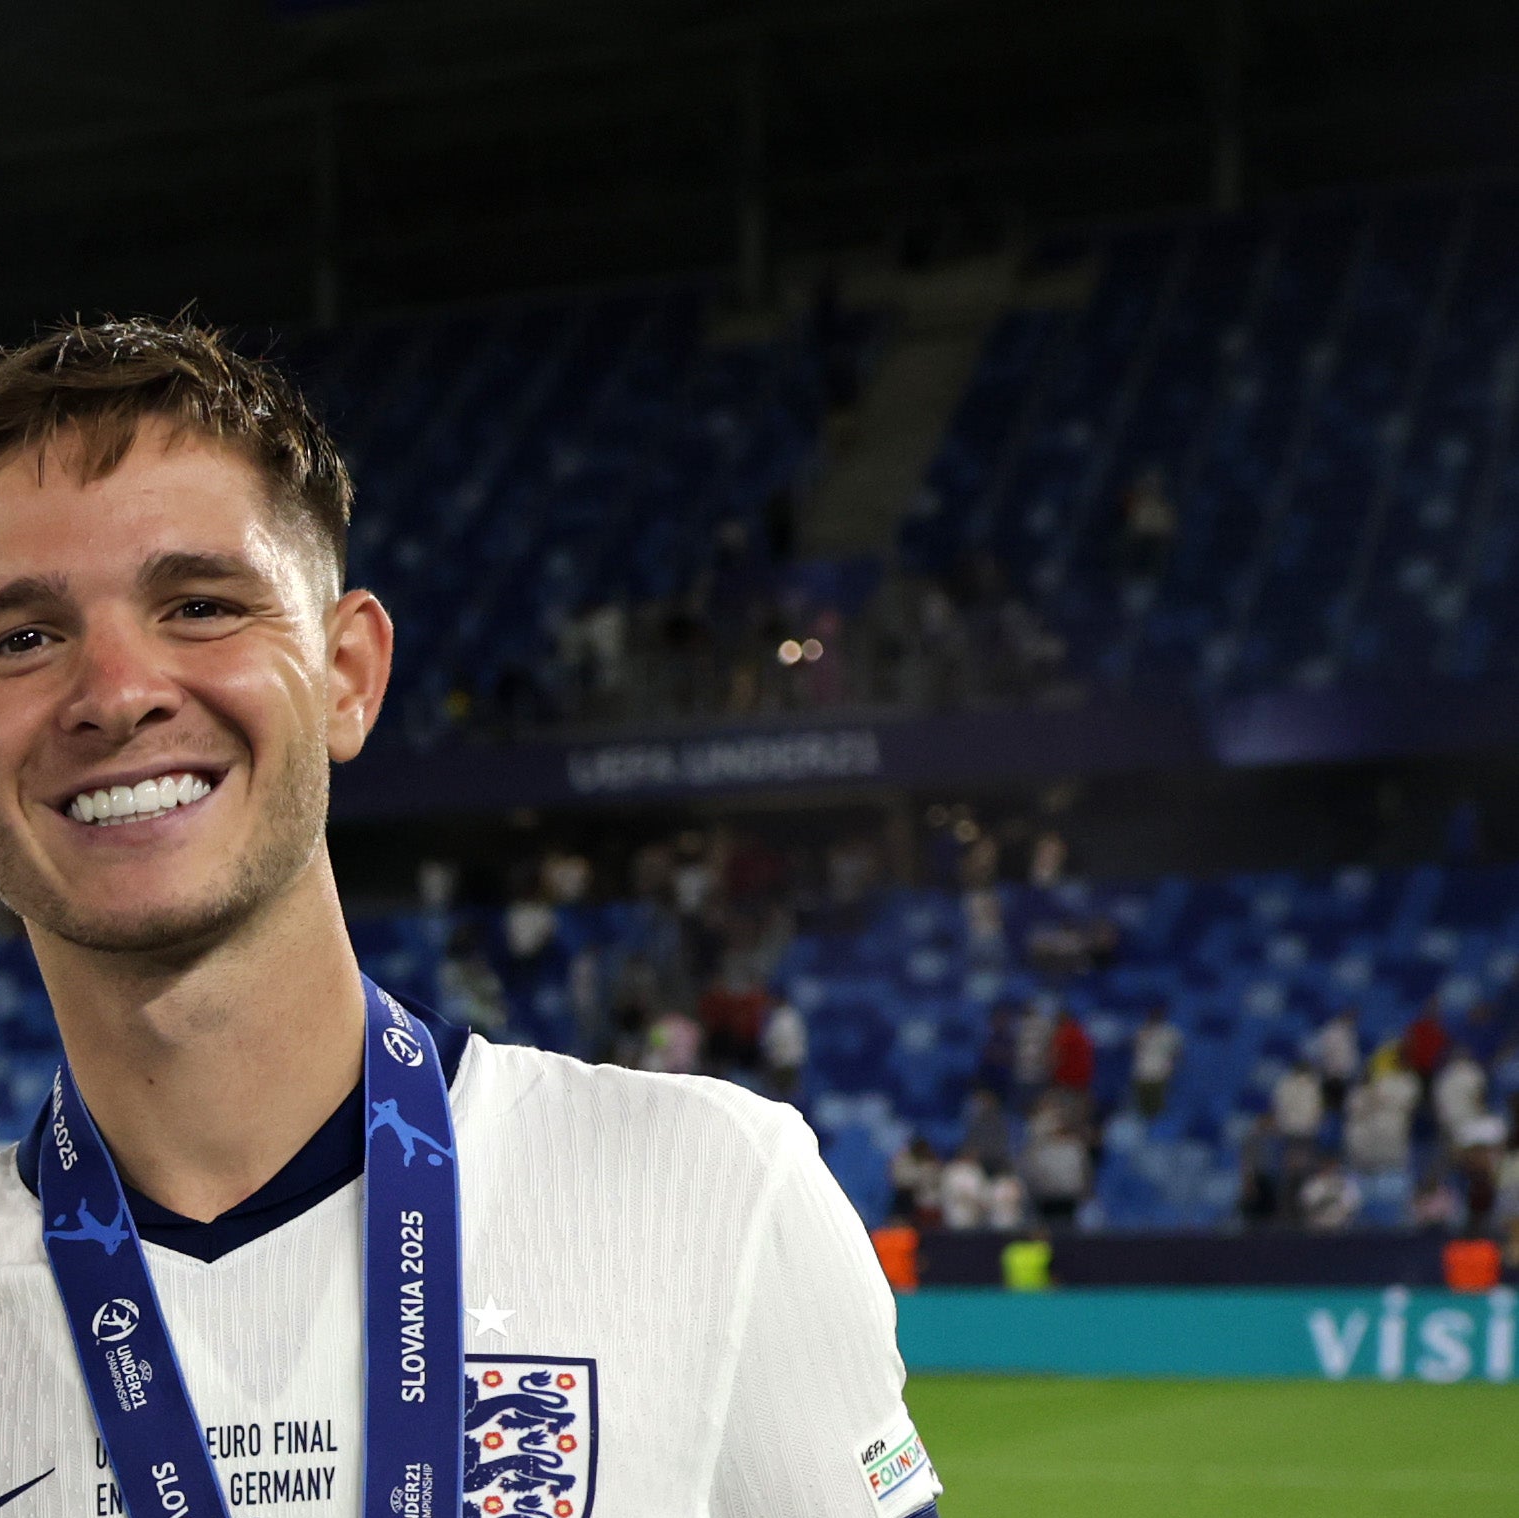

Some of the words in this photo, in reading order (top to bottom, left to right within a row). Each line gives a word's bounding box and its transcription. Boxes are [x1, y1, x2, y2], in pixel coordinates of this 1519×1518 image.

[54, 1115, 78, 1171] 2025
[400, 1210, 424, 1274] 2025
[400, 1279, 426, 1403] SLOVAKIA
[105, 1350, 132, 1412] CHAMPIONSHIP
[116, 1344, 148, 1410] UNDER21
[274, 1419, 338, 1455] FINAL
[860, 1438, 887, 1466] UEFA
[230, 1466, 336, 1506] GERMANY
